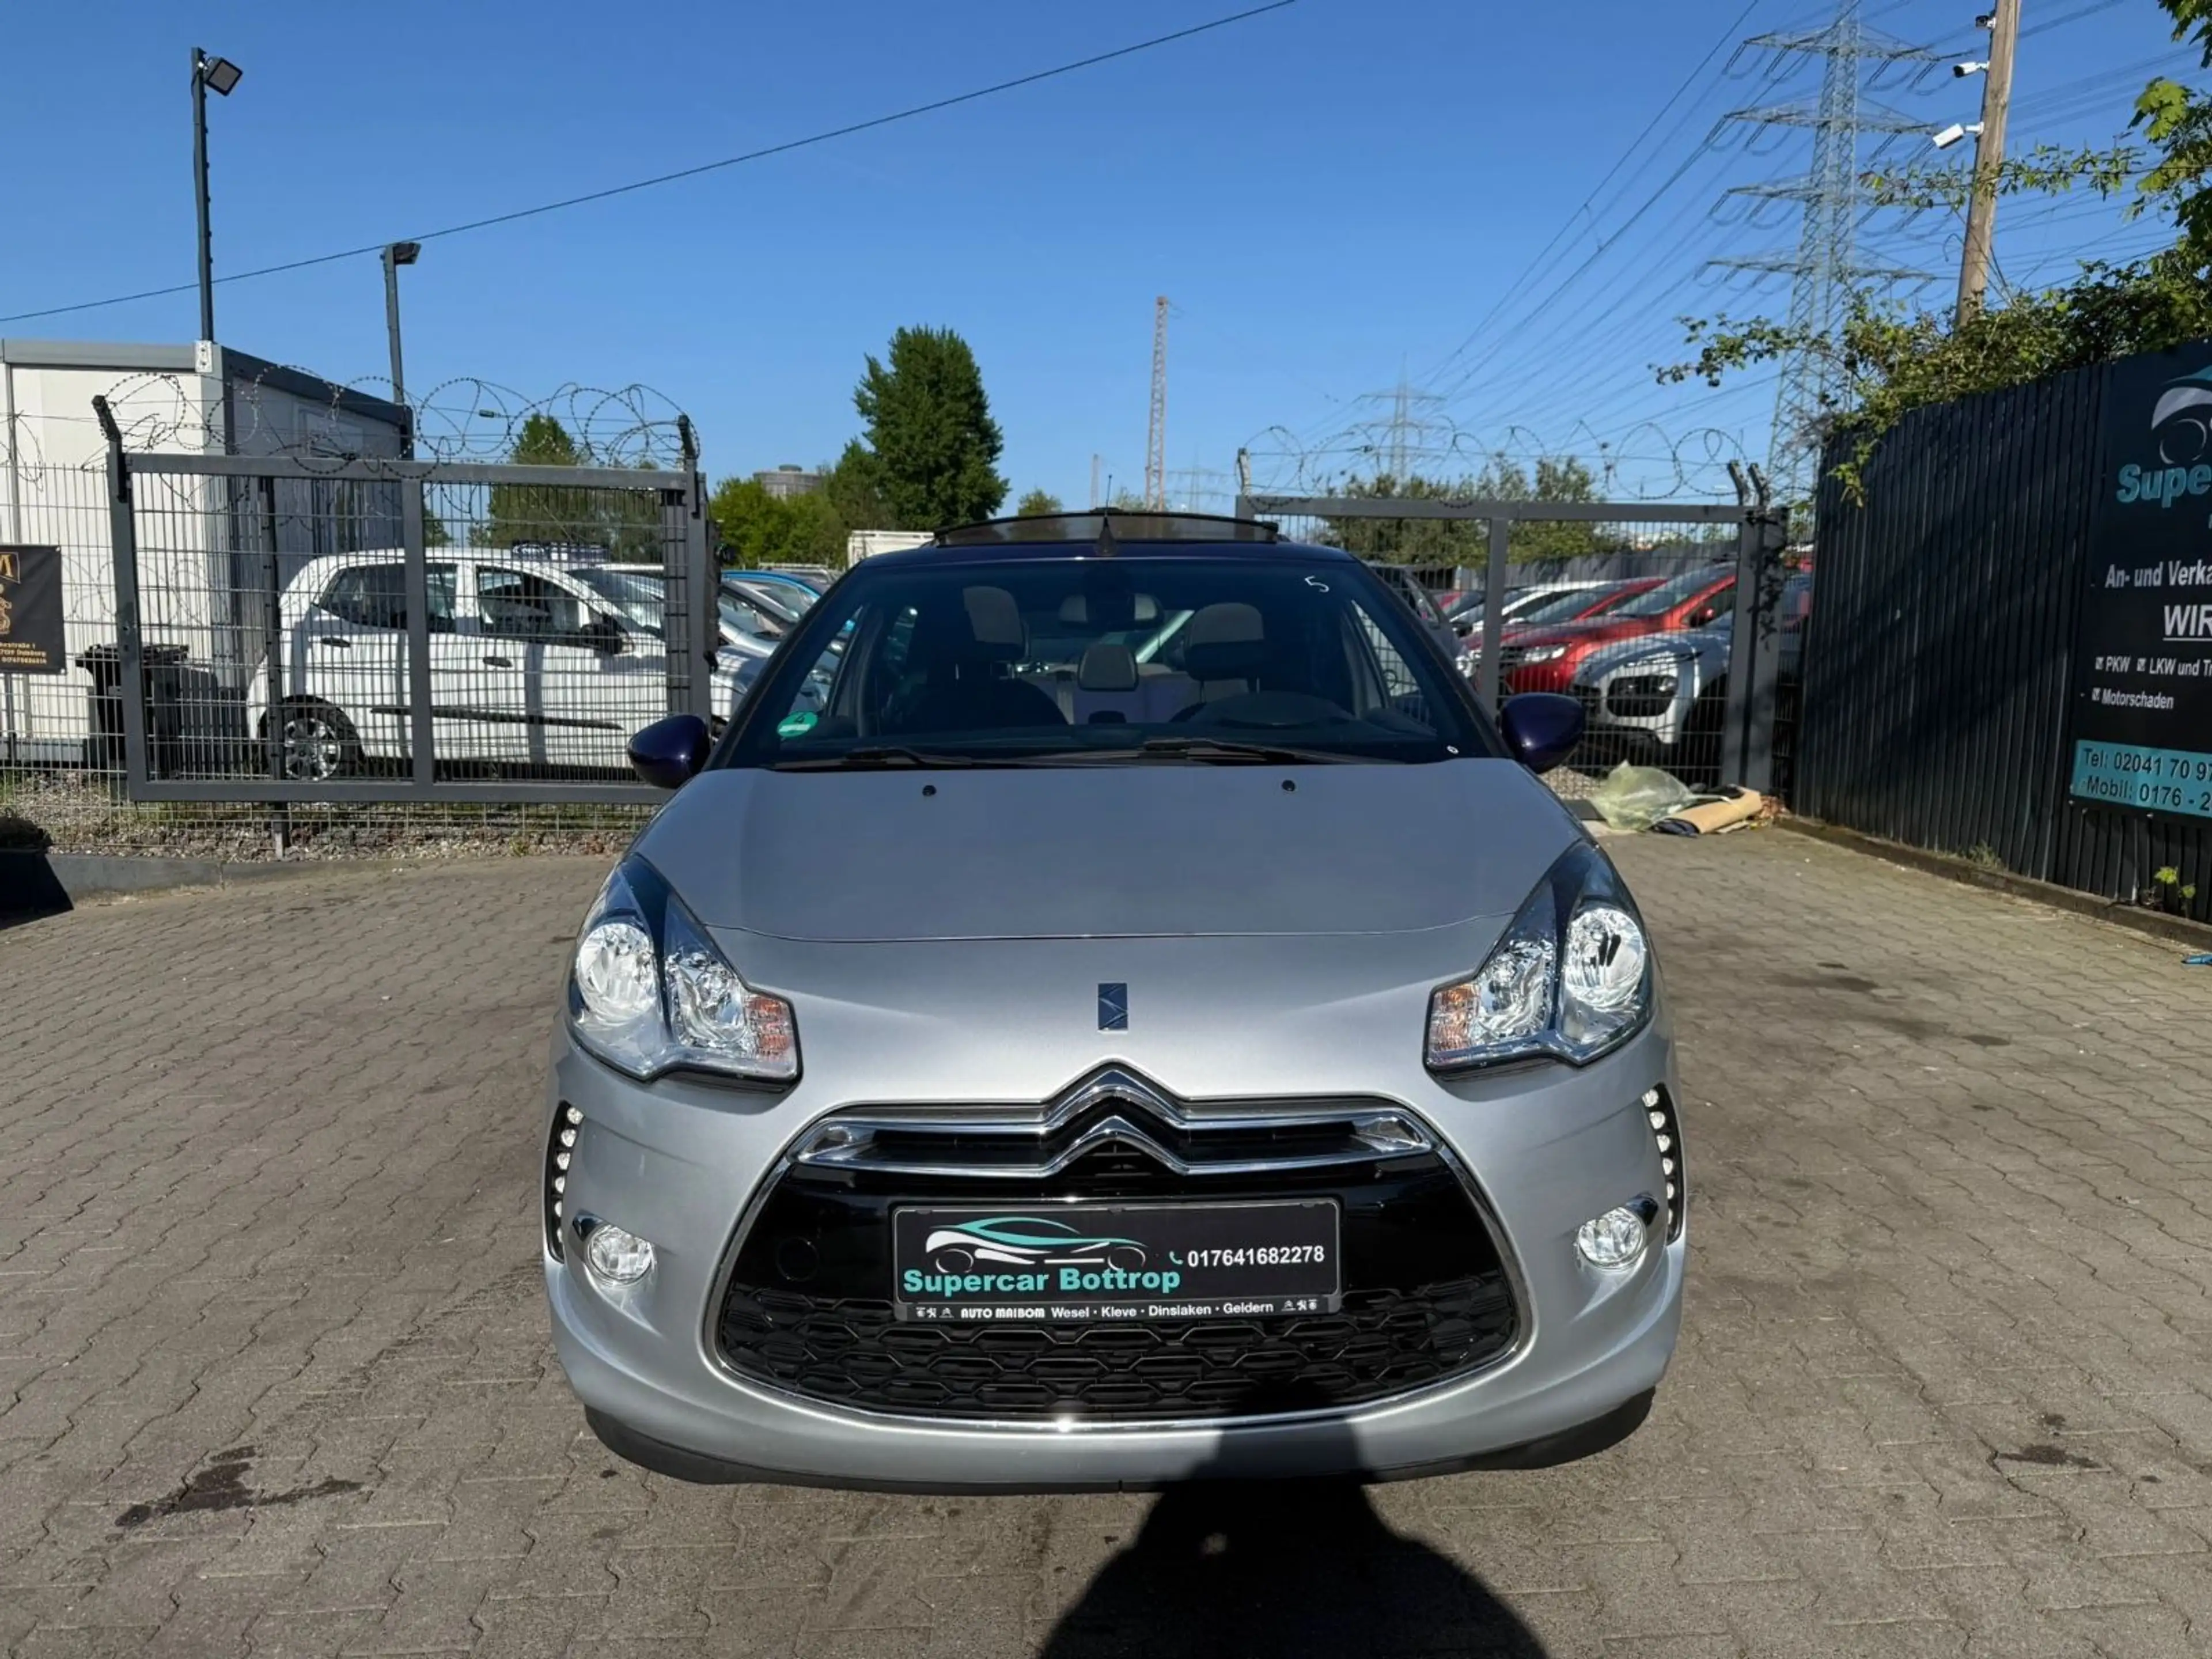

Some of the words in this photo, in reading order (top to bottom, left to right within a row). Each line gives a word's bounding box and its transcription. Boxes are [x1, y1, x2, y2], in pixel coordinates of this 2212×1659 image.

[2105, 564, 2130, 588] An-
[2134, 561, 2164, 587] und
[2164, 605, 2212, 637] WIR
[2105, 656, 2131, 673] PKW
[2149, 658, 2176, 675] LKW
[2177, 659, 2200, 676] und
[2101, 688, 2175, 709] Motorschaden
[2084, 748, 2108, 769] Tel:
[2114, 752, 2162, 776] 02041
[2170, 758, 2190, 779] 70
[2087, 775, 2133, 800] Mobil:
[2139, 783, 2182, 806] 0176
[2199, 791, 2211, 811] 2
[1188, 1245, 1325, 1267] 017641682278
[903, 1269, 1050, 1297] Supercar
[1059, 1267, 1181, 1294] Bottrop
[961, 1307, 993, 1319] AUTO
[1051, 1306, 1089, 1318] Wesel
[1101, 1305, 1137, 1317] Kleve
[1149, 1304, 1211, 1317] Dinslaken
[1223, 1302, 1274, 1314] Geldern
